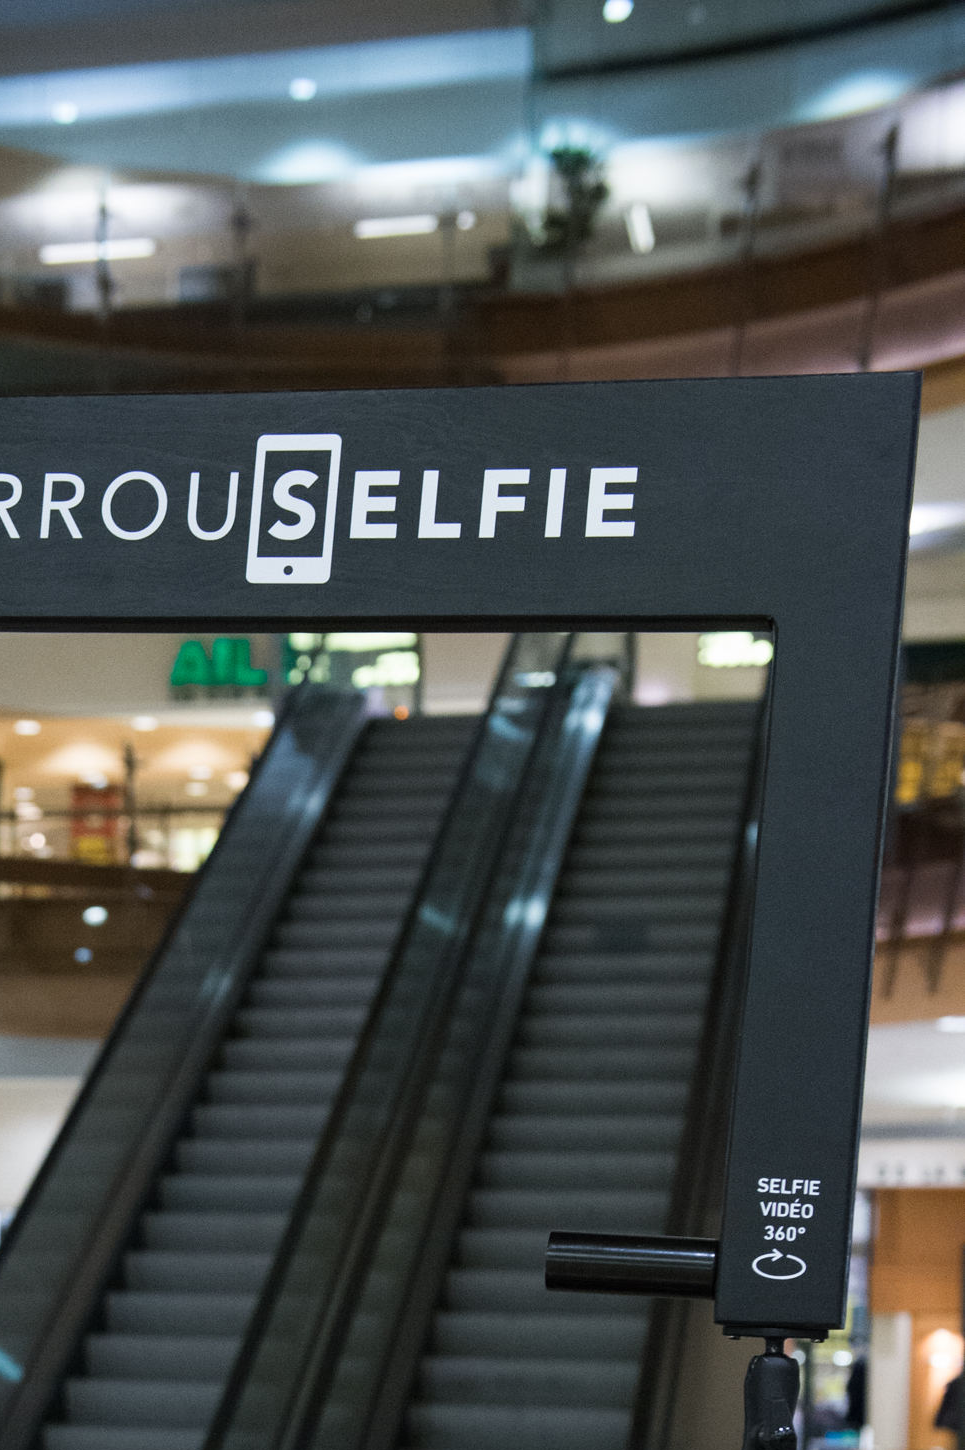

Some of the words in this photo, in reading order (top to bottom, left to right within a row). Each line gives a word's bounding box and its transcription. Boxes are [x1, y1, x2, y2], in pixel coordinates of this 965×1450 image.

[757, 1177, 821, 1196] SELFIE
[760, 1198, 814, 1219] VIDÉO
[764, 1225, 806, 1241] 360°
